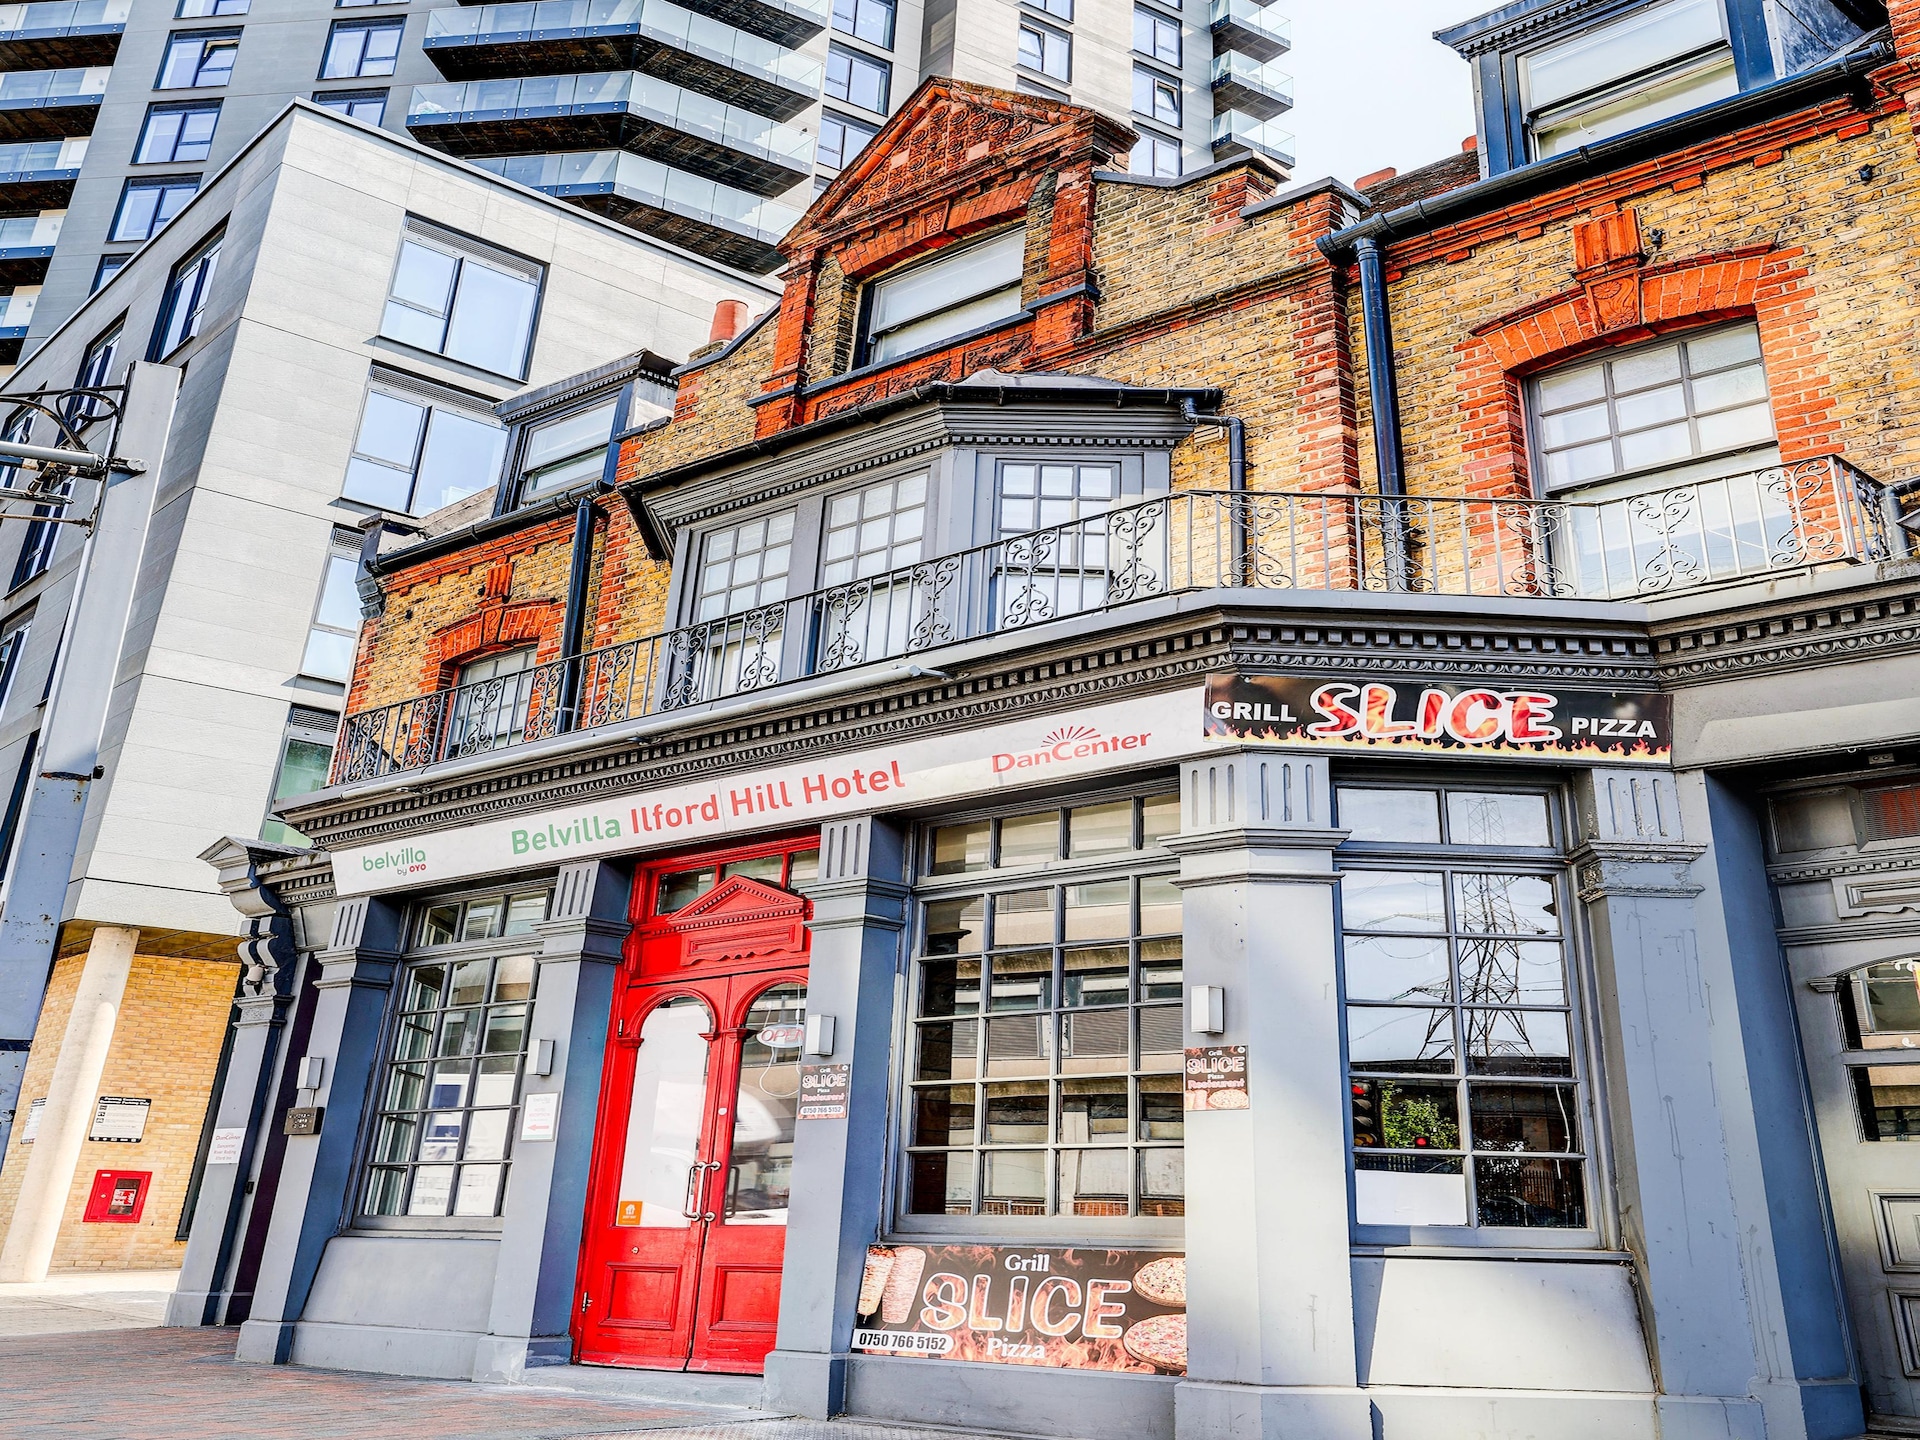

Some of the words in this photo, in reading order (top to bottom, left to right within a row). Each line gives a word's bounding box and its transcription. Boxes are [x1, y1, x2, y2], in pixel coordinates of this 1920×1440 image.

[1210, 701, 1297, 722] GRILL
[1307, 682, 1564, 743] SLICE
[1571, 717, 1657, 738] PIZZA
[991, 732, 1152, 773] DanCenter
[511, 816, 621, 855] Belvilla
[631, 794, 719, 834] Ilford
[730, 781, 793, 817] Hill
[802, 760, 906, 804] Hotel
[362, 847, 426, 872] belvilla
[397, 868, 407, 876] by
[409, 863, 427, 873] OYO
[761, 1028, 805, 1042] OPEN
[1186, 1056, 1246, 1074] SLICE
[802, 1073, 847, 1089] SLICE
[1004, 1253, 1050, 1273] Grill
[919, 1272, 1133, 1339] SLICE
[858, 1333, 891, 1347] 0750
[892, 1334, 915, 1348] 766
[916, 1336, 948, 1350] 5152
[985, 1337, 1045, 1360] Pizza
